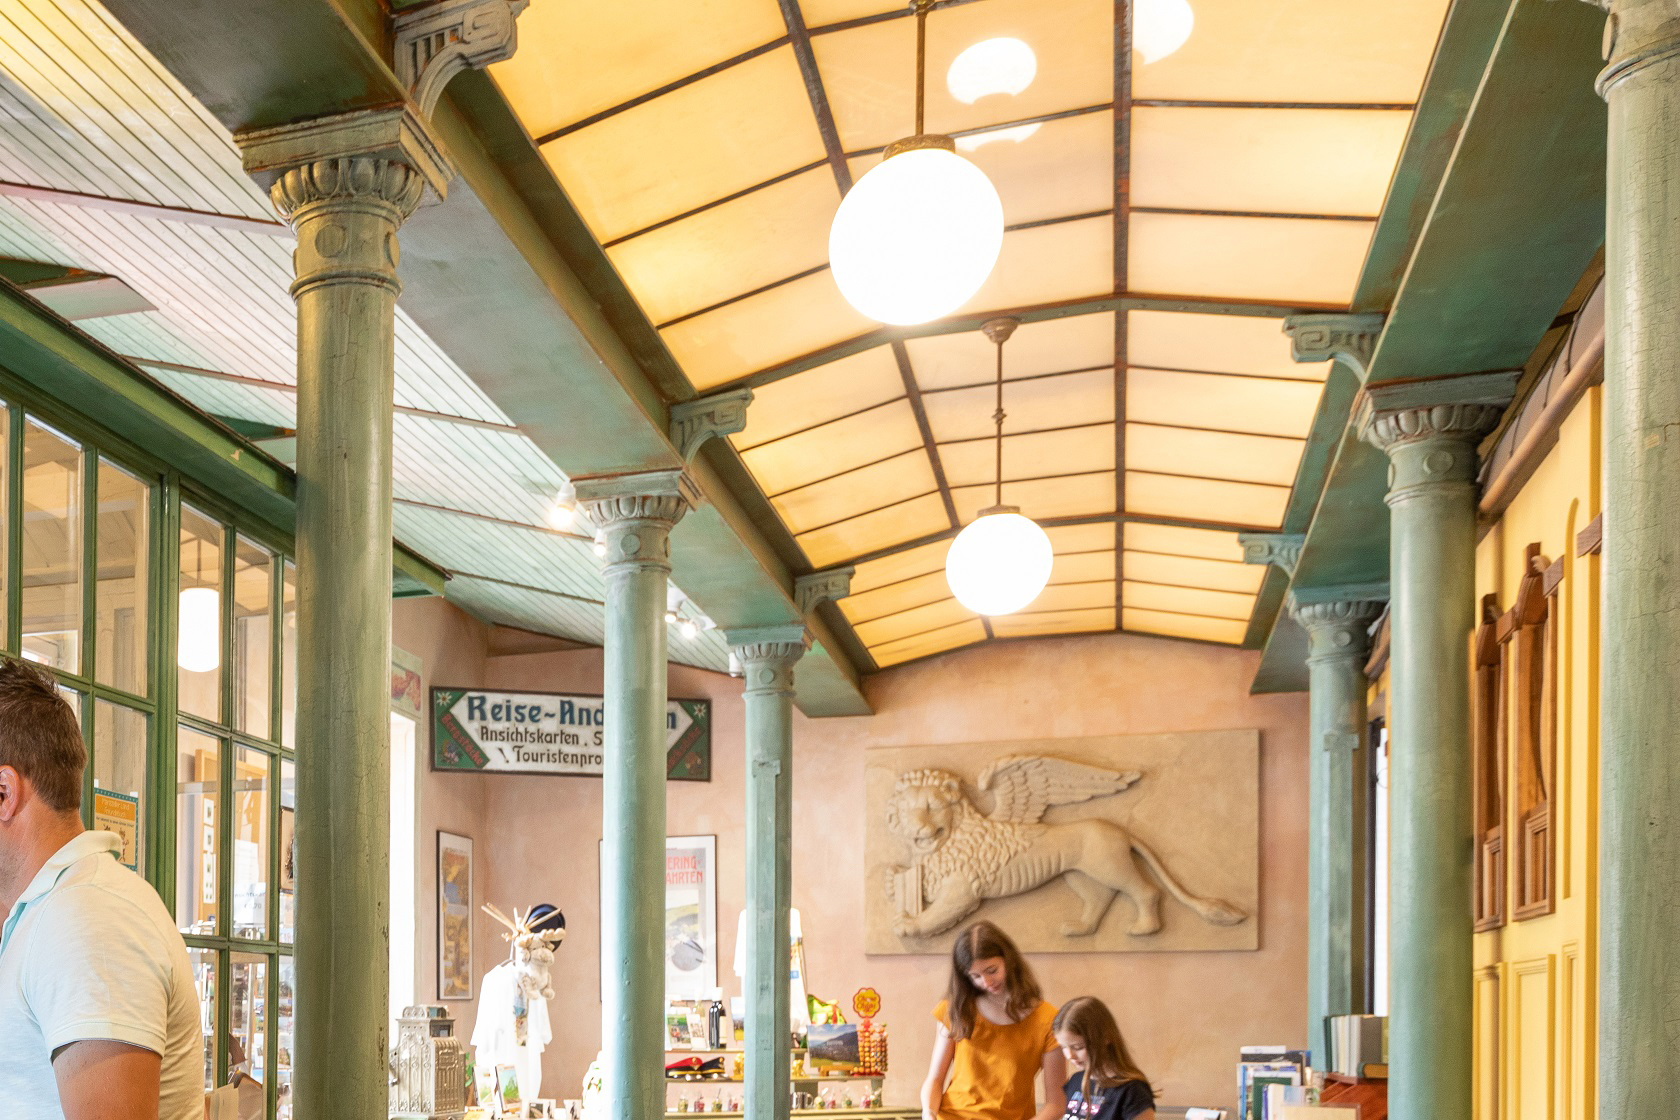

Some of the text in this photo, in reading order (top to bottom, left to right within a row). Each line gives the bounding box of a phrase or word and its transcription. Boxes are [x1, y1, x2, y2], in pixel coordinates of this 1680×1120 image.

[480, 725, 579, 745] Ansichtskarten
[512, 745, 604, 768] Touristenpro
[667, 855, 702, 871] ERING-
[666, 871, 704, 885] AHRTEN
